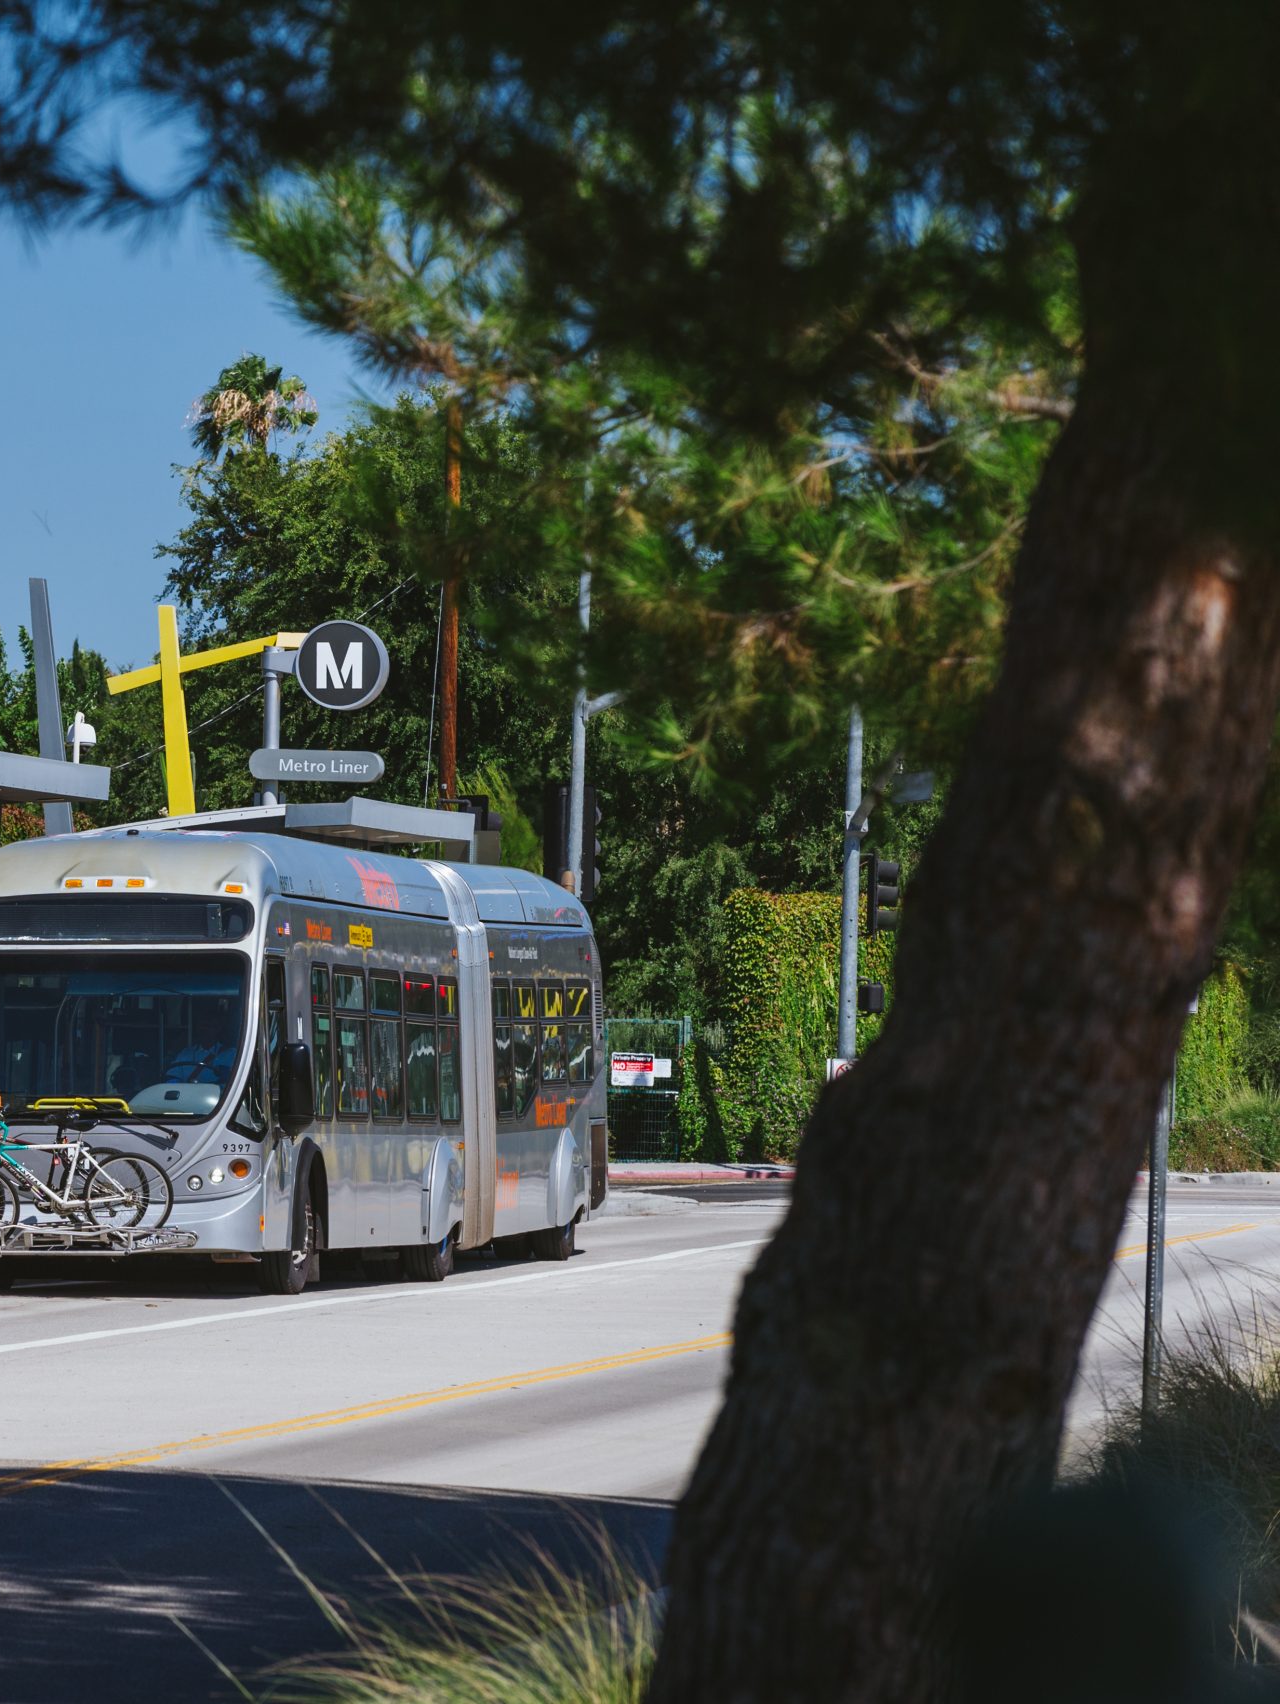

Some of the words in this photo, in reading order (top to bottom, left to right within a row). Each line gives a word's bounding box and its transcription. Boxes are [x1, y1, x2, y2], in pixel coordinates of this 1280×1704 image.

[316, 642, 363, 689] M
[279, 759, 326, 773] Metro
[331, 760, 369, 774] Liner
[613, 1062, 626, 1070] NO
[222, 1143, 251, 1153] 9397
